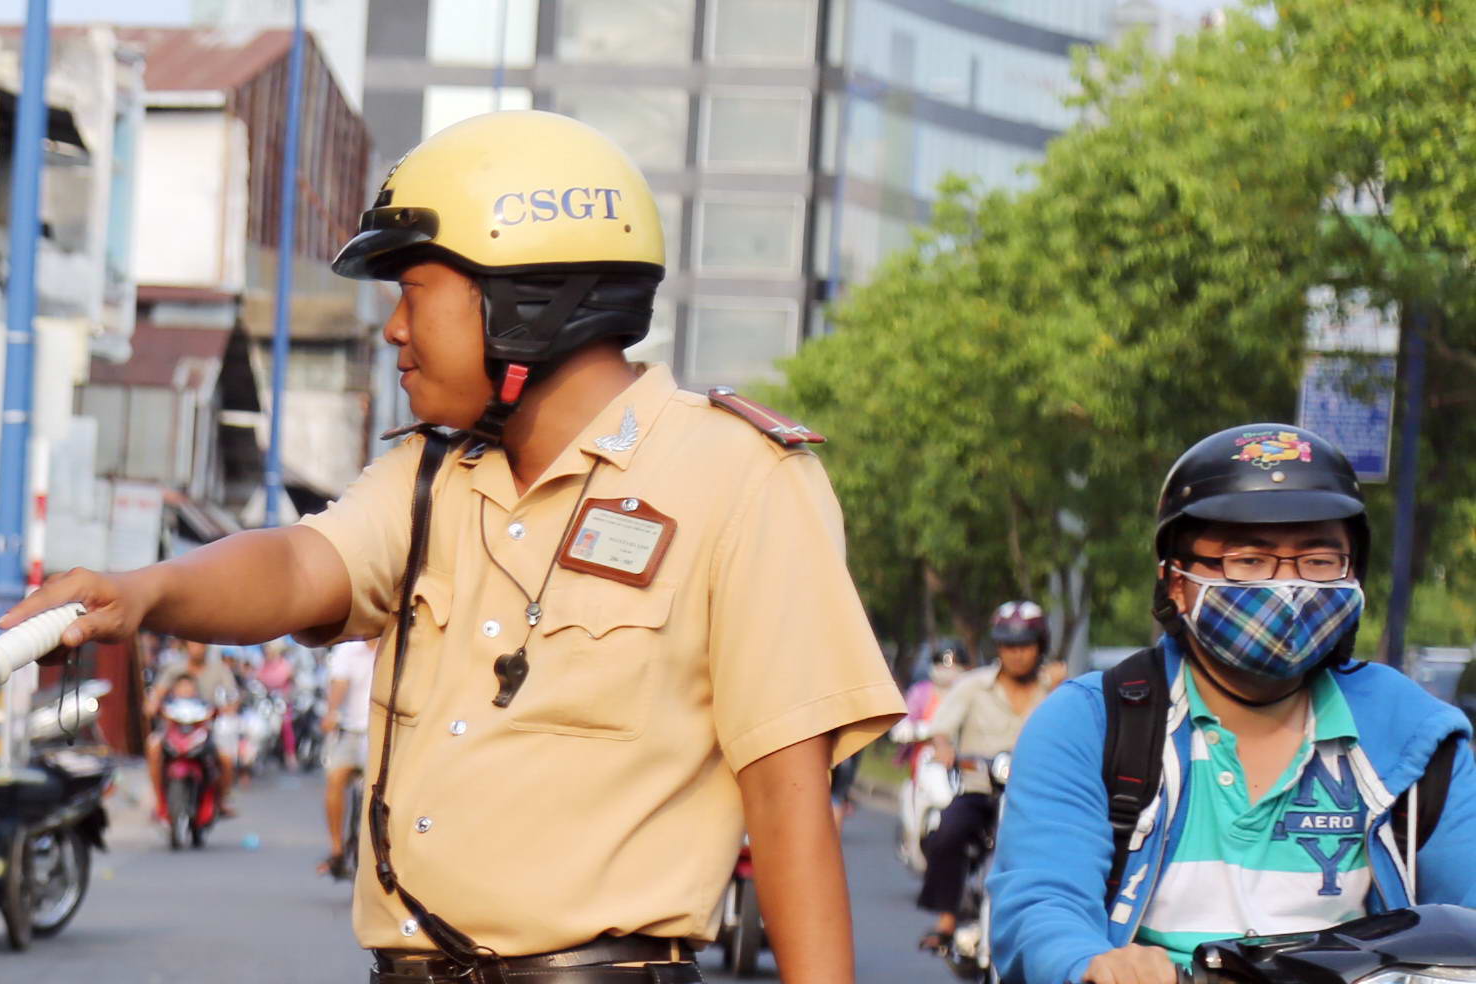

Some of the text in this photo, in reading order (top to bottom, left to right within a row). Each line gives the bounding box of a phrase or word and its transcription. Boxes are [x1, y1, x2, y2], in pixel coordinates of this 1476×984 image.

[493, 187, 621, 226] CSGT
[1300, 815, 1354, 829] AERO
[1295, 836, 1364, 896] Y
